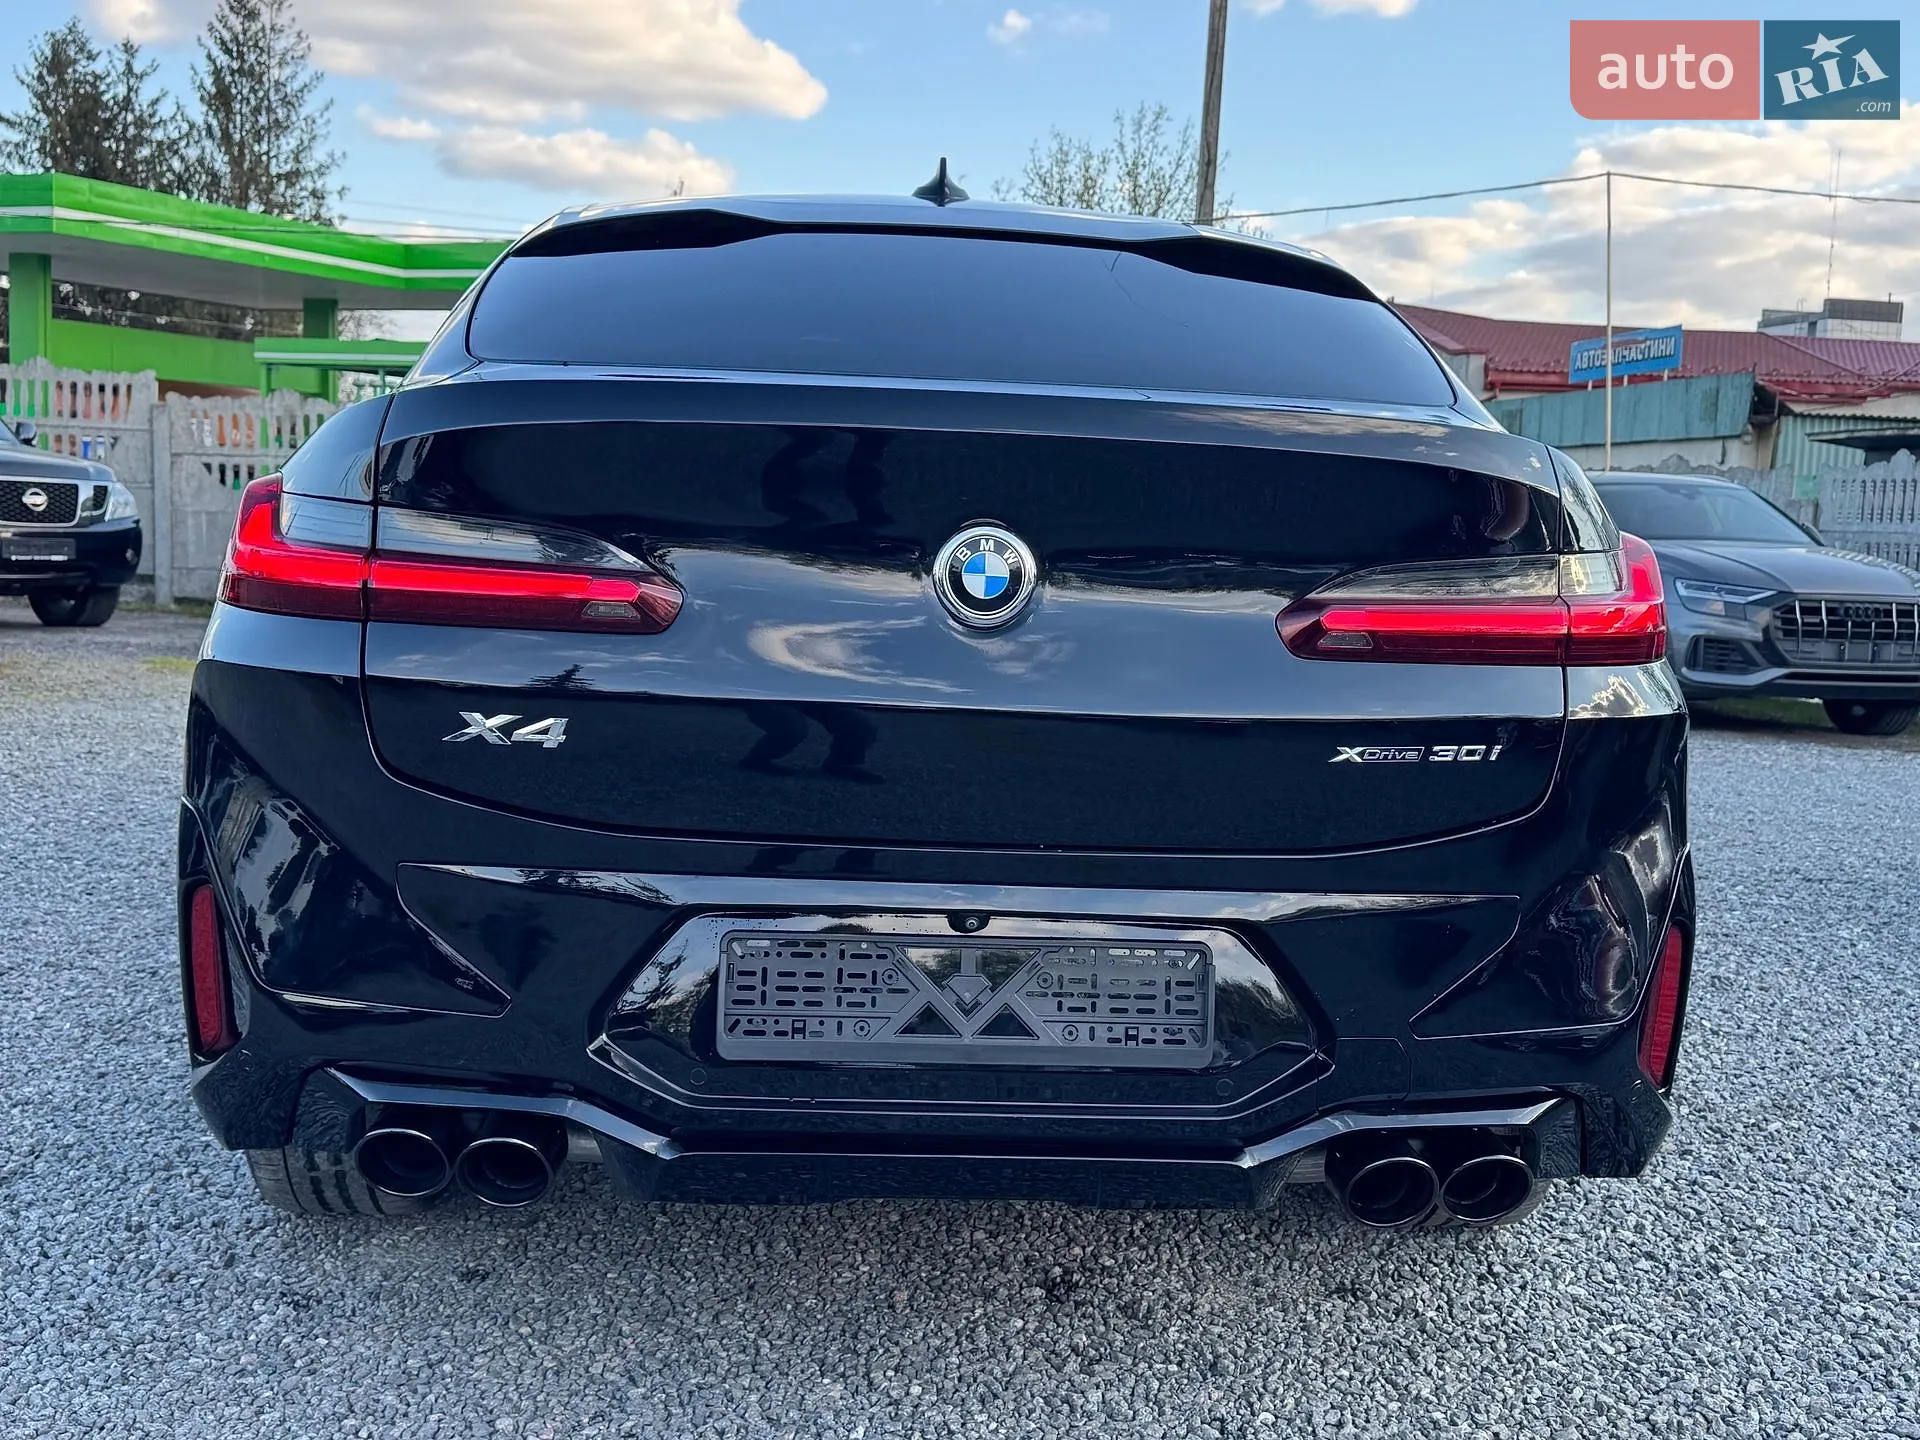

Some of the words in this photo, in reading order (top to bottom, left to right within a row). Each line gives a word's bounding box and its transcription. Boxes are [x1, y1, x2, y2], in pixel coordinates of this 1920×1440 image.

[956, 538, 1019, 565] BMW
[441, 711, 569, 748] X4
[1429, 745, 1503, 761] 30i
